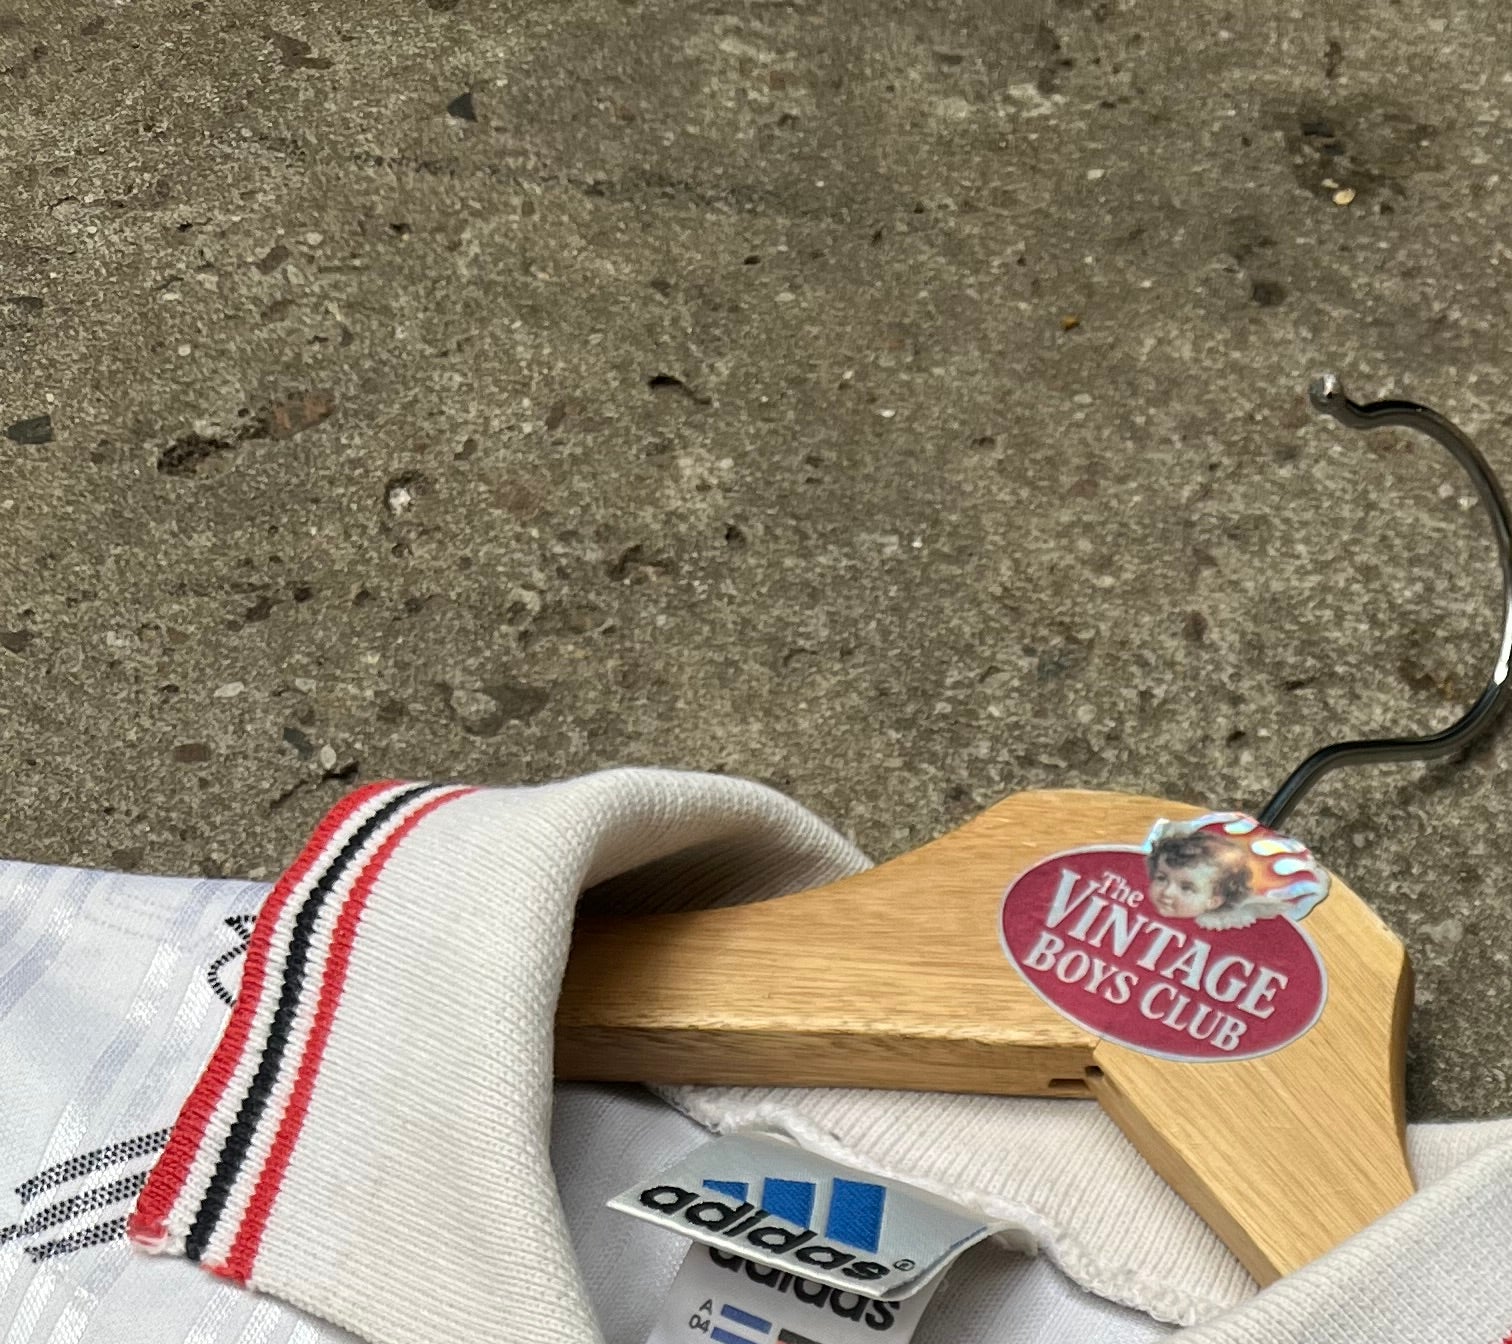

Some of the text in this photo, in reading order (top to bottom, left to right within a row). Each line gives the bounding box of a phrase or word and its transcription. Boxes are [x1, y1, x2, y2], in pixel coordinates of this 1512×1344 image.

[1099, 871, 1144, 907] The
[1045, 868, 1289, 1019] VINTAGE
[1023, 931, 1247, 1051] BOYS CLUB
[688, 1314, 711, 1334] 04
[699, 1299, 713, 1315] A
